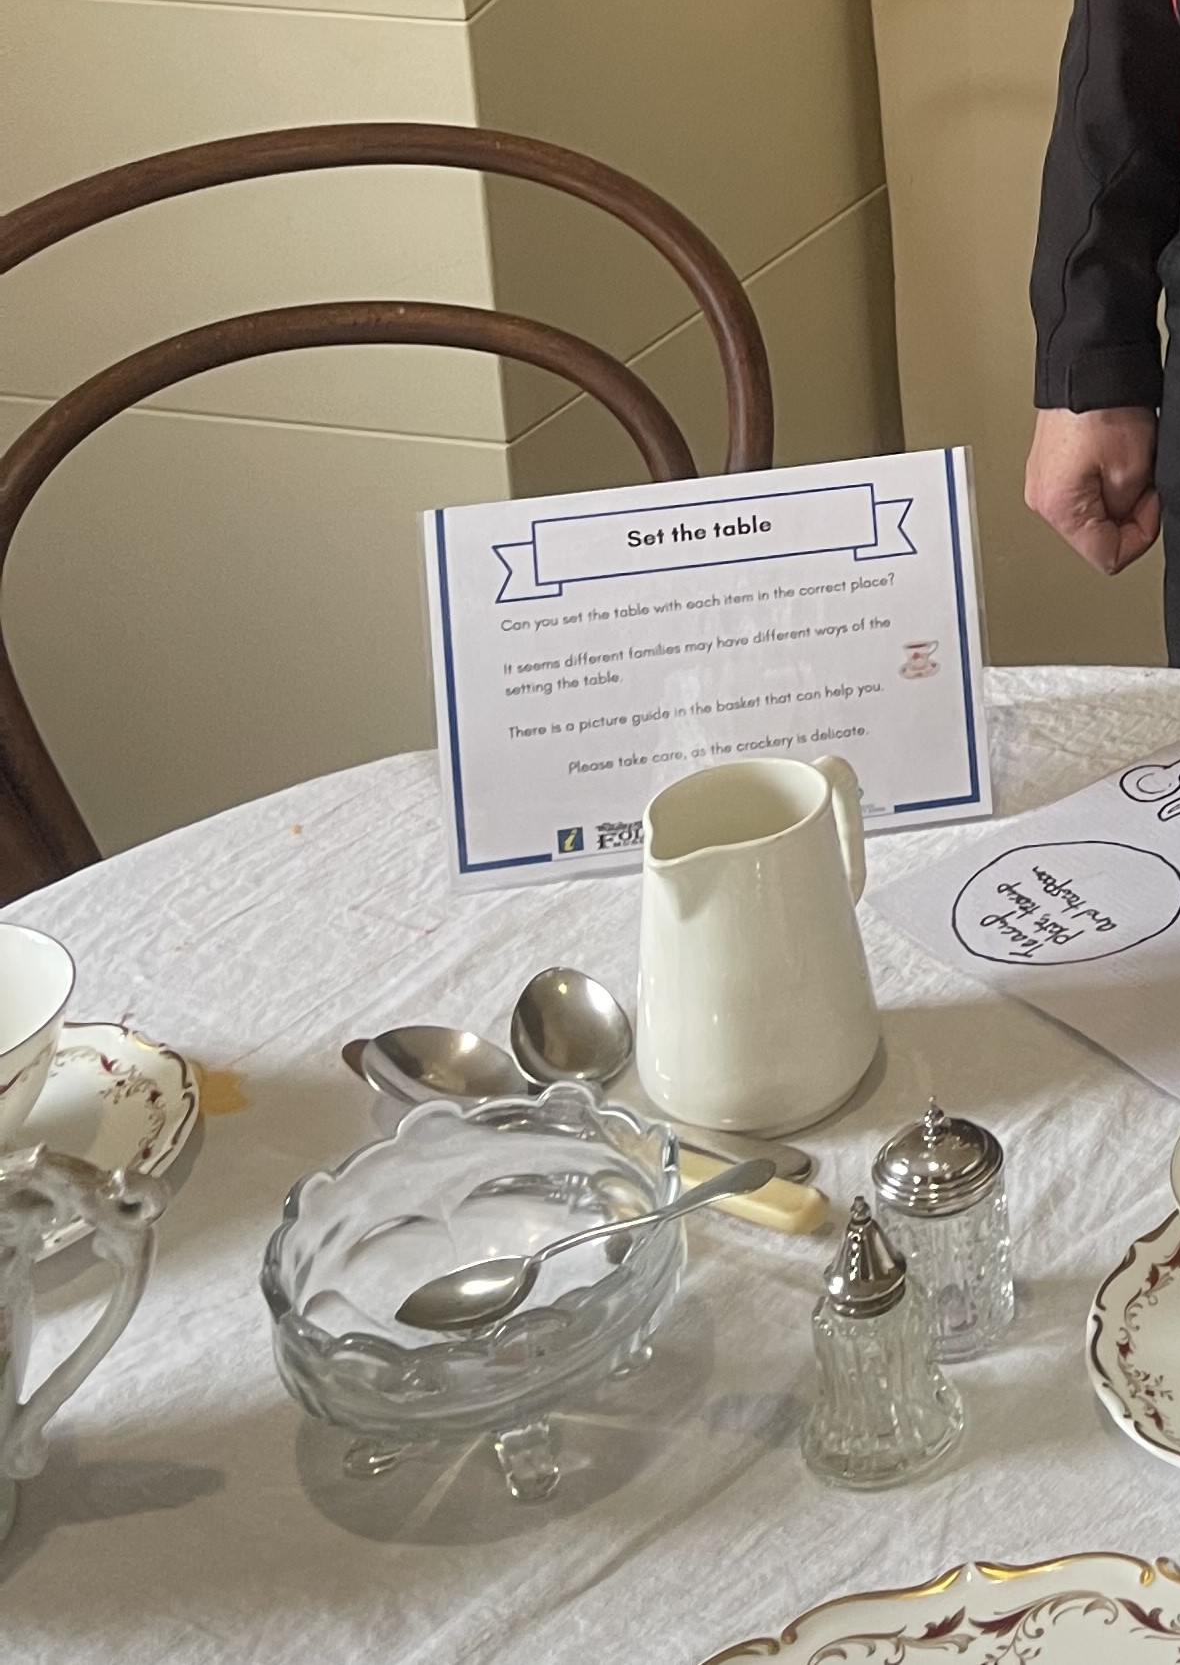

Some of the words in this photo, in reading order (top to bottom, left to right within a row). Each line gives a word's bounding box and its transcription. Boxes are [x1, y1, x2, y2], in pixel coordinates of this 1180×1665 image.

[627, 528, 664, 547] Set
[671, 523, 707, 542] the
[713, 514, 772, 538] table
[500, 618, 531, 632] Can
[534, 618, 559, 633] you
[562, 612, 583, 625] set
[587, 608, 610, 621] the
[614, 602, 650, 619] table
[653, 597, 682, 614] with
[686, 594, 721, 610] each
[723, 593, 754, 605] item
[757, 589, 770, 601] in
[773, 586, 795, 599] the
[799, 580, 847, 597] correct
[850, 572, 896, 593] place?
[503, 663, 513, 675] It
[517, 660, 560, 674] seems
[564, 649, 624, 668] different
[628, 643, 681, 660] families
[684, 640, 713, 654] may
[716, 636, 749, 649] have
[753, 626, 811, 644] different
[814, 624, 849, 638] ways
[852, 617, 866, 632] of
[869, 614, 891, 629] the
[505, 680, 553, 696] setting
[557, 676, 580, 690] the
[584, 670, 624, 686] table.
[509, 724, 547, 740] There
[551, 722, 562, 734] is
[565, 722, 575, 733] a
[579, 714, 628, 734] picture
[631, 706, 670, 728] guide
[674, 706, 687, 718] in
[690, 701, 713, 714] the
[716, 695, 761, 712] basket
[765, 692, 792, 706] that
[796, 690, 822, 702] can
[824, 683, 854, 700] help
[857, 682, 885, 699] you.
[568, 759, 614, 775] Please
[618, 751, 648, 768] take
[651, 750, 688, 764] care,
[690, 747, 707, 758] as
[710, 741, 733, 755] the
[735, 733, 794, 753] crockery
[796, 732, 807, 744] is
[810, 725, 870, 743] delicate.
[979, 910, 1044, 958] Teacup
[1070, 909, 1118, 932] and
